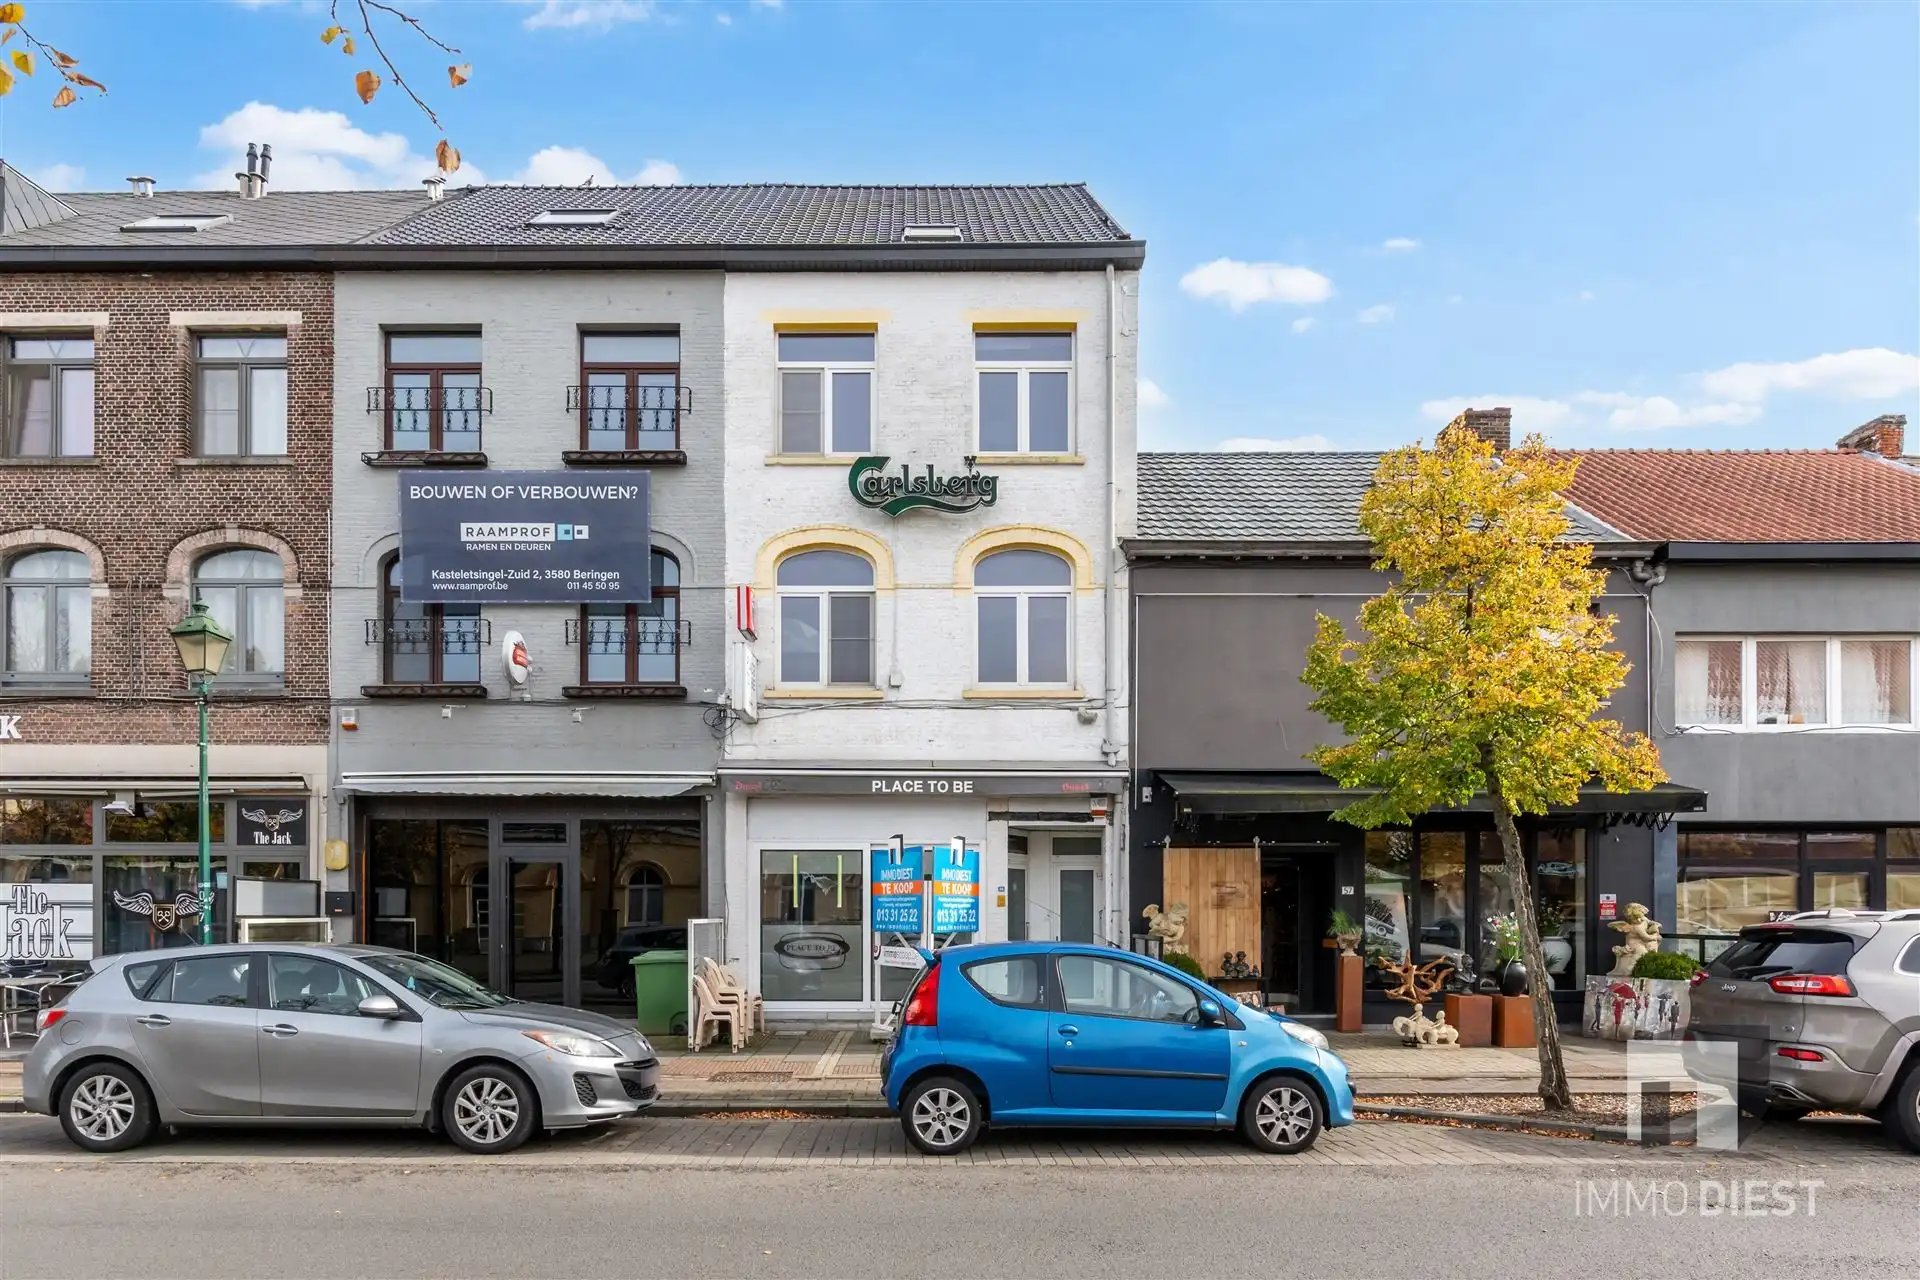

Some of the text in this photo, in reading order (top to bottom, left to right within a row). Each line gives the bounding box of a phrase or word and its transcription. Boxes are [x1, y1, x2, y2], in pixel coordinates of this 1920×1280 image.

[848, 456, 1000, 510] Carlsberg
[410, 485, 638, 500] BOUWEN OF VERBOUWEN?
[466, 527, 551, 537] RAAMPROF
[466, 543, 551, 551] RAMEN EN DEUREN
[432, 569, 620, 581] Kasteletsingel-Zuid 2, 3580 Beringen
[432, 582, 509, 591] www.raamprof.be
[567, 582, 620, 590] 011 45 50 95
[0, 715, 22, 739] K
[871, 780, 974, 793] PLACE TO BE
[253, 831, 292, 845] The Jack
[880, 868, 914, 880] IMMO DIEST
[881, 883, 914, 895] TE KOOP
[941, 882, 972, 895] TE KOOP
[12, 884, 48, 914] The
[876, 909, 918, 922] 013 31 25 22
[937, 909, 976, 923] 013 31 25 22
[1721, 983, 1737, 993] Jeep
